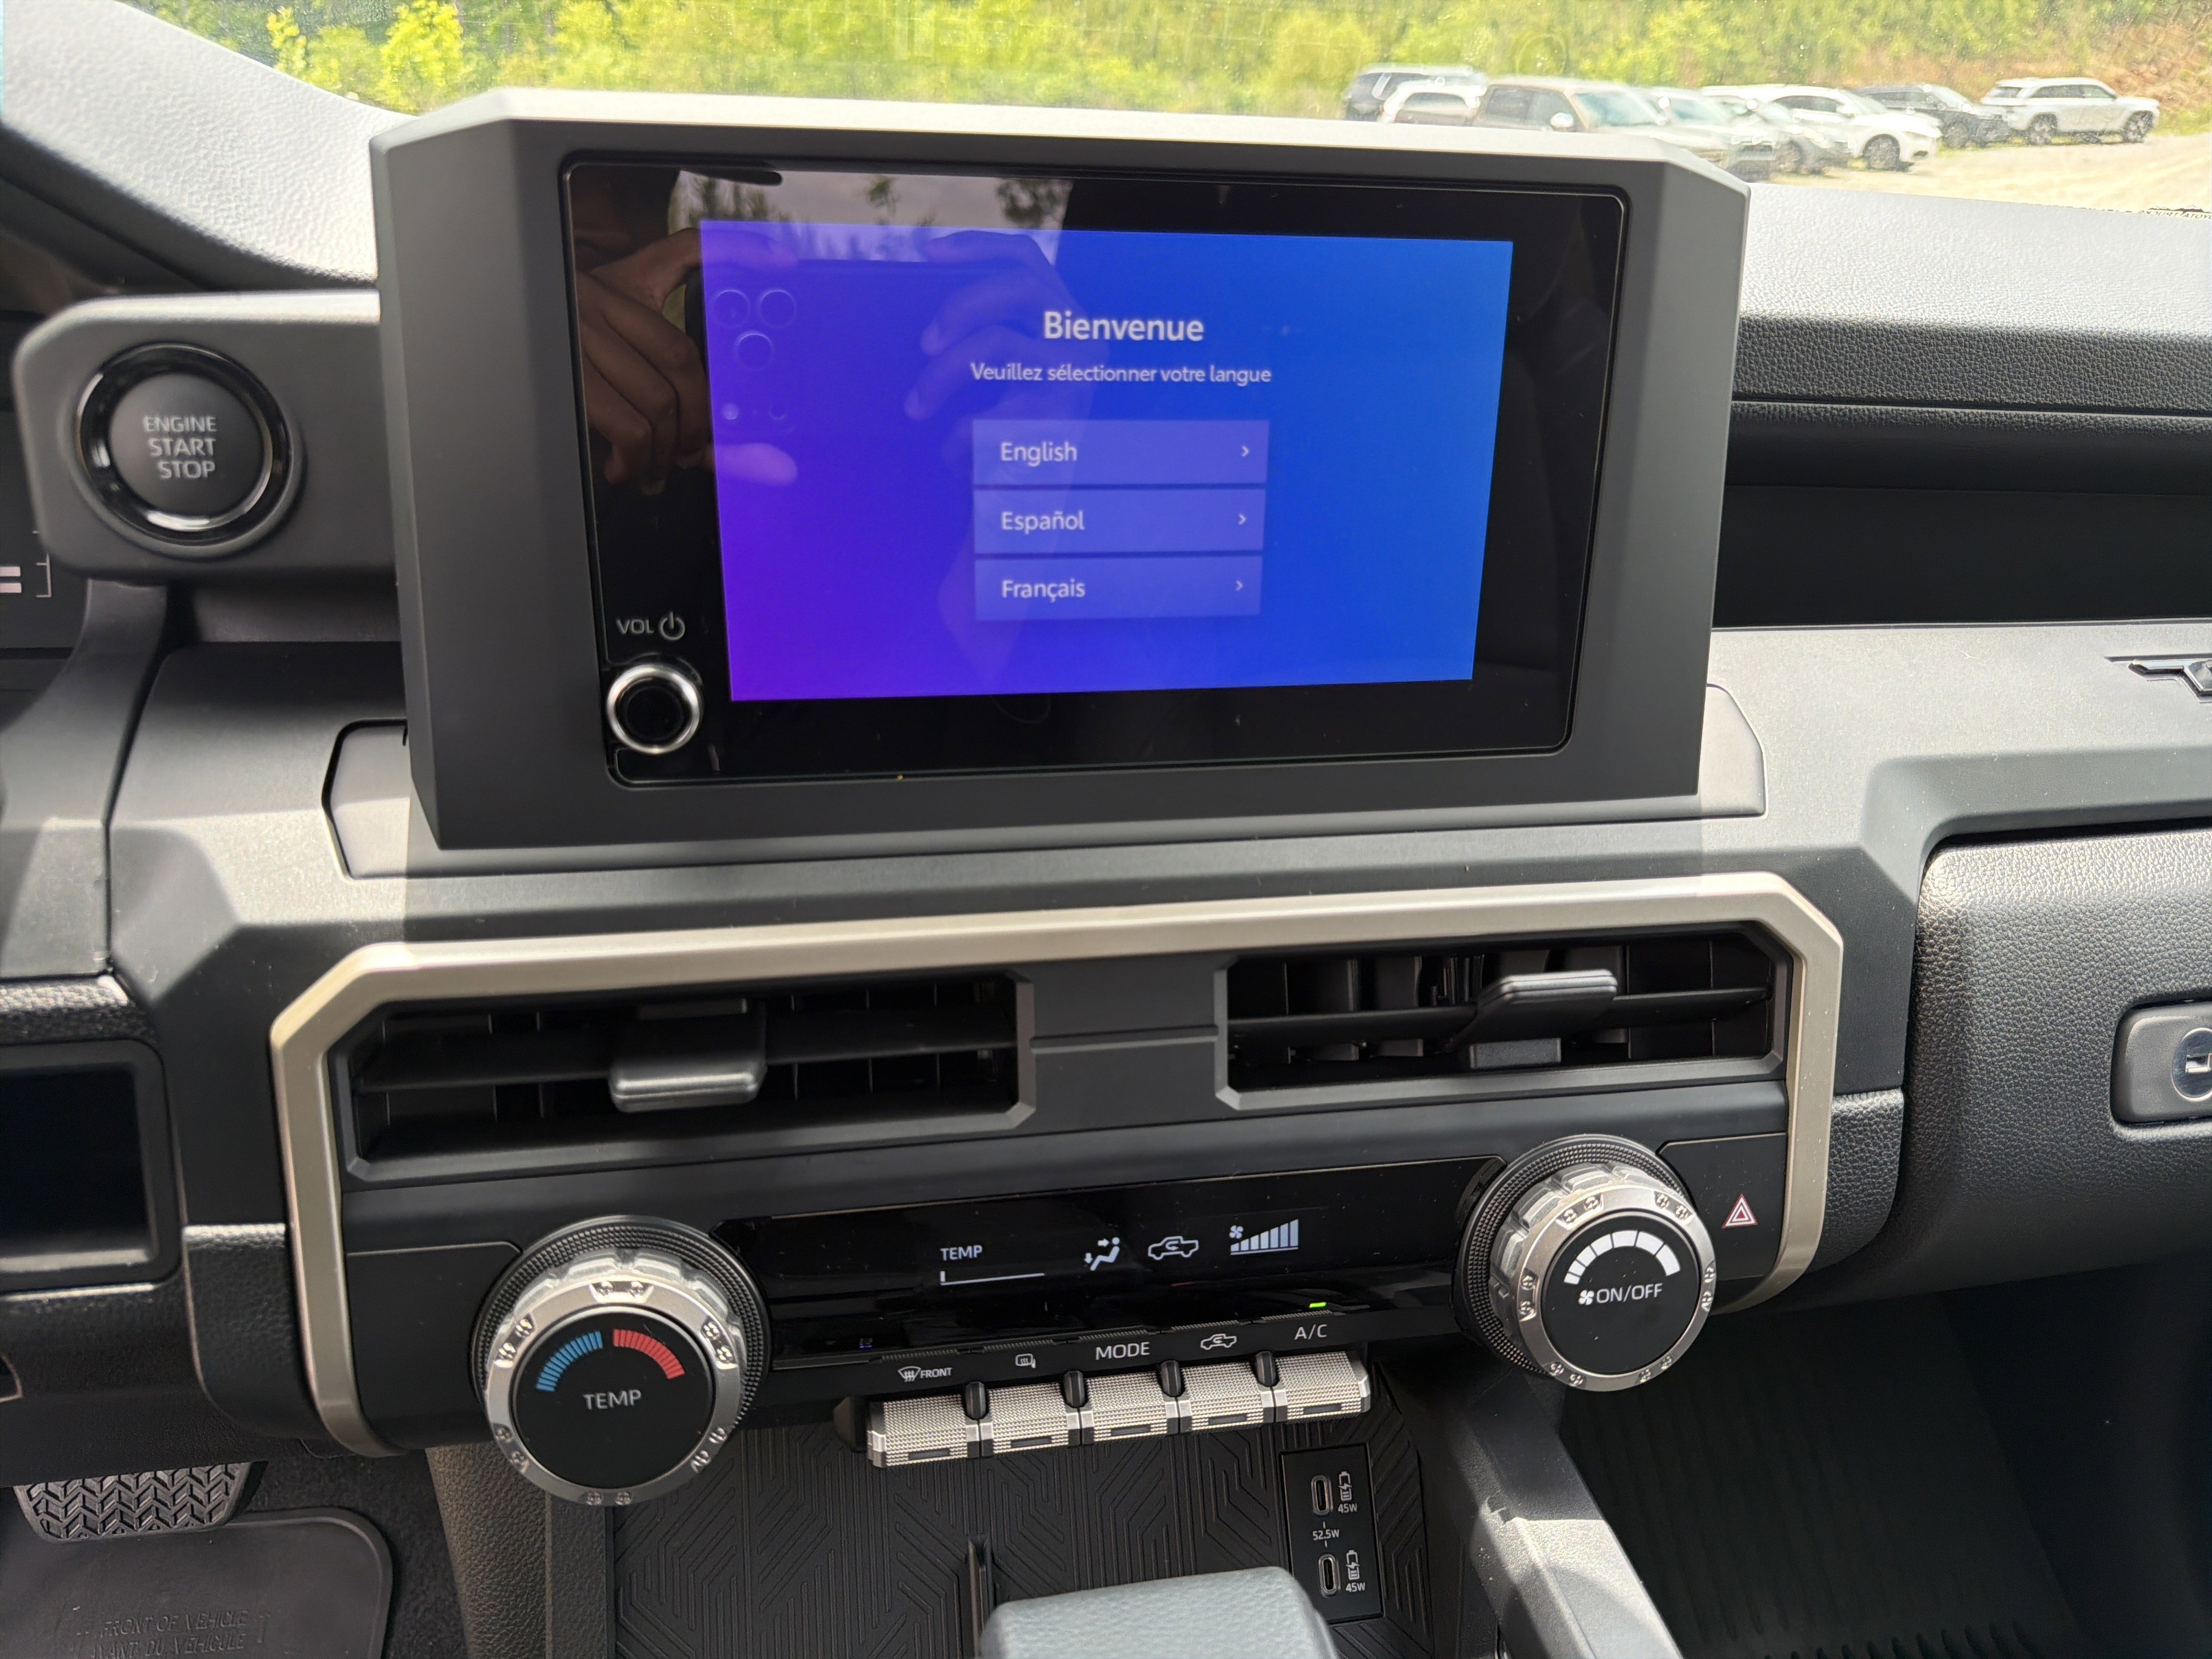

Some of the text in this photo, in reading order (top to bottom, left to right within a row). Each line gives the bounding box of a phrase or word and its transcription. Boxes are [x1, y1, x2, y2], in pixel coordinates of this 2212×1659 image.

[1044, 311, 1205, 342] Bienvenue
[970, 363, 1272, 387] Veuillez sélectionner votre langue
[143, 415, 218, 432] ENGINE
[148, 437, 216, 456] START
[1001, 441, 1078, 467] English
[157, 460, 216, 479] STOP
[1001, 510, 1086, 535] Español
[1002, 578, 1086, 603] Français
[616, 618, 654, 634] VOL
[940, 1244, 983, 1262] TEMP
[1596, 1283, 1663, 1304] ON/OFF
[1294, 1323, 1327, 1340] A/C
[1096, 1341, 1150, 1361] MODE
[920, 1367, 953, 1379] FRONT
[582, 1389, 642, 1410] TEMP
[1338, 1503, 1357, 1514] 45W
[1312, 1529, 1340, 1541] 52.5W
[1345, 1582, 1365, 1593] 45W
[100, 1611, 249, 1638] FRONT OF VEHICLE
